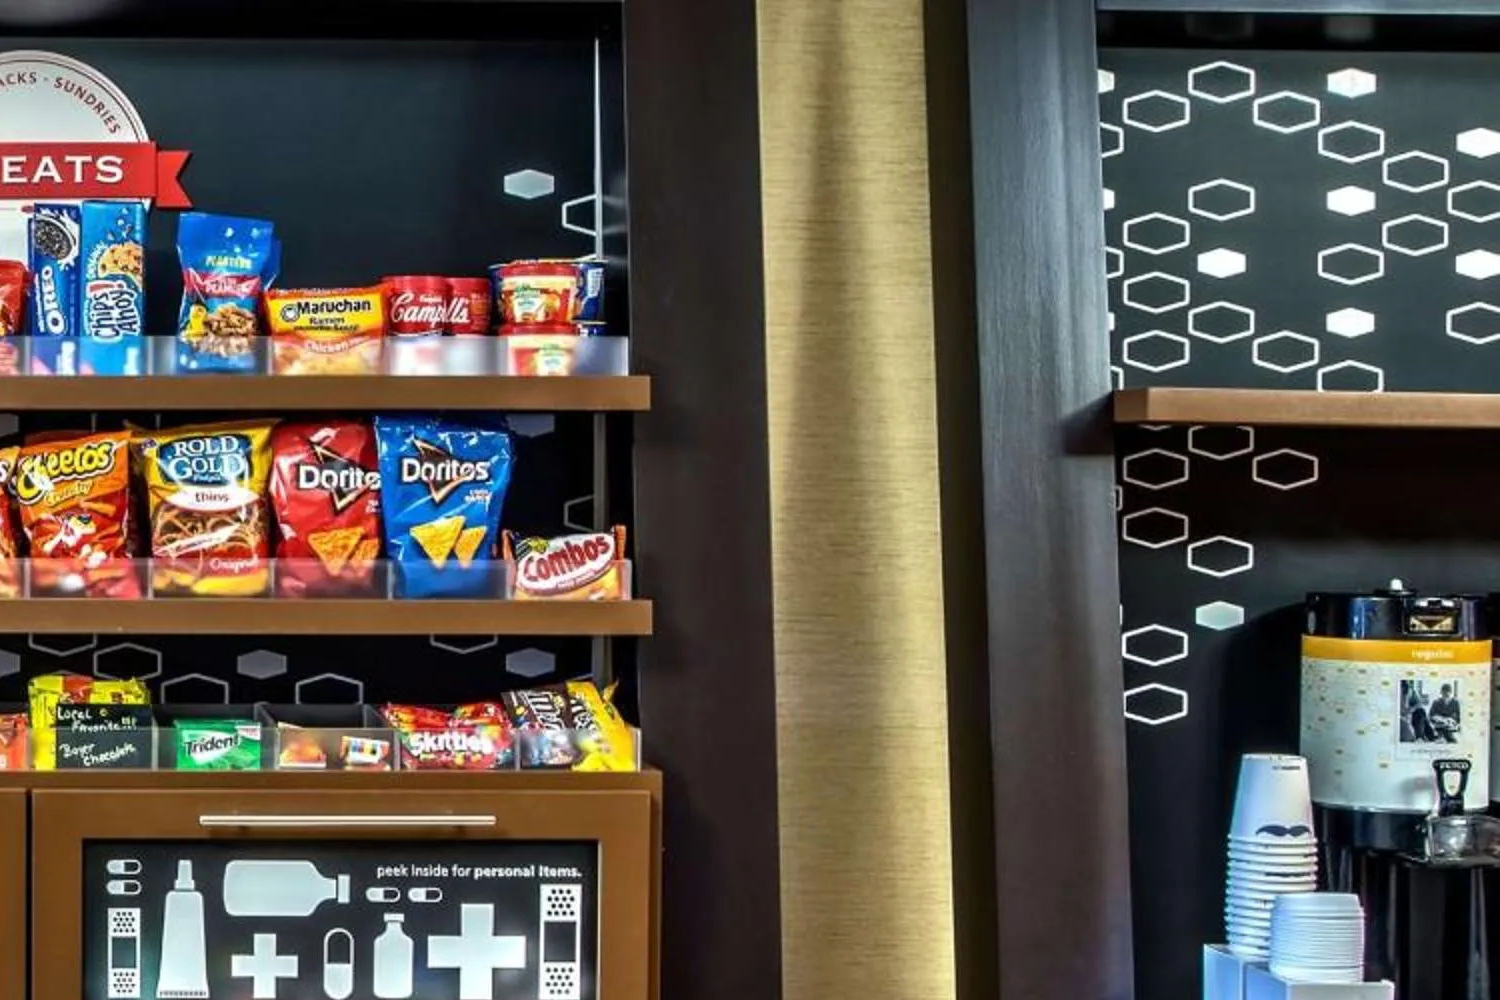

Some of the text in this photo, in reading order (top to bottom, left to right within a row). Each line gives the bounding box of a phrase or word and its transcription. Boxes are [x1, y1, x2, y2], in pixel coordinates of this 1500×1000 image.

[53, 76, 121, 135] SUNDRIES
[40, 265, 68, 335] OREO
[297, 298, 372, 315] Maruchan
[91, 291, 119, 340] Chips
[174, 435, 241, 457] ROLD
[169, 453, 245, 480] GOLD
[299, 465, 381, 490] Dorito
[402, 457, 492, 483] Doritos
[57, 706, 93, 721] Local
[184, 733, 240, 756] Trident
[377, 864, 583, 880] peek inside for personal items.
